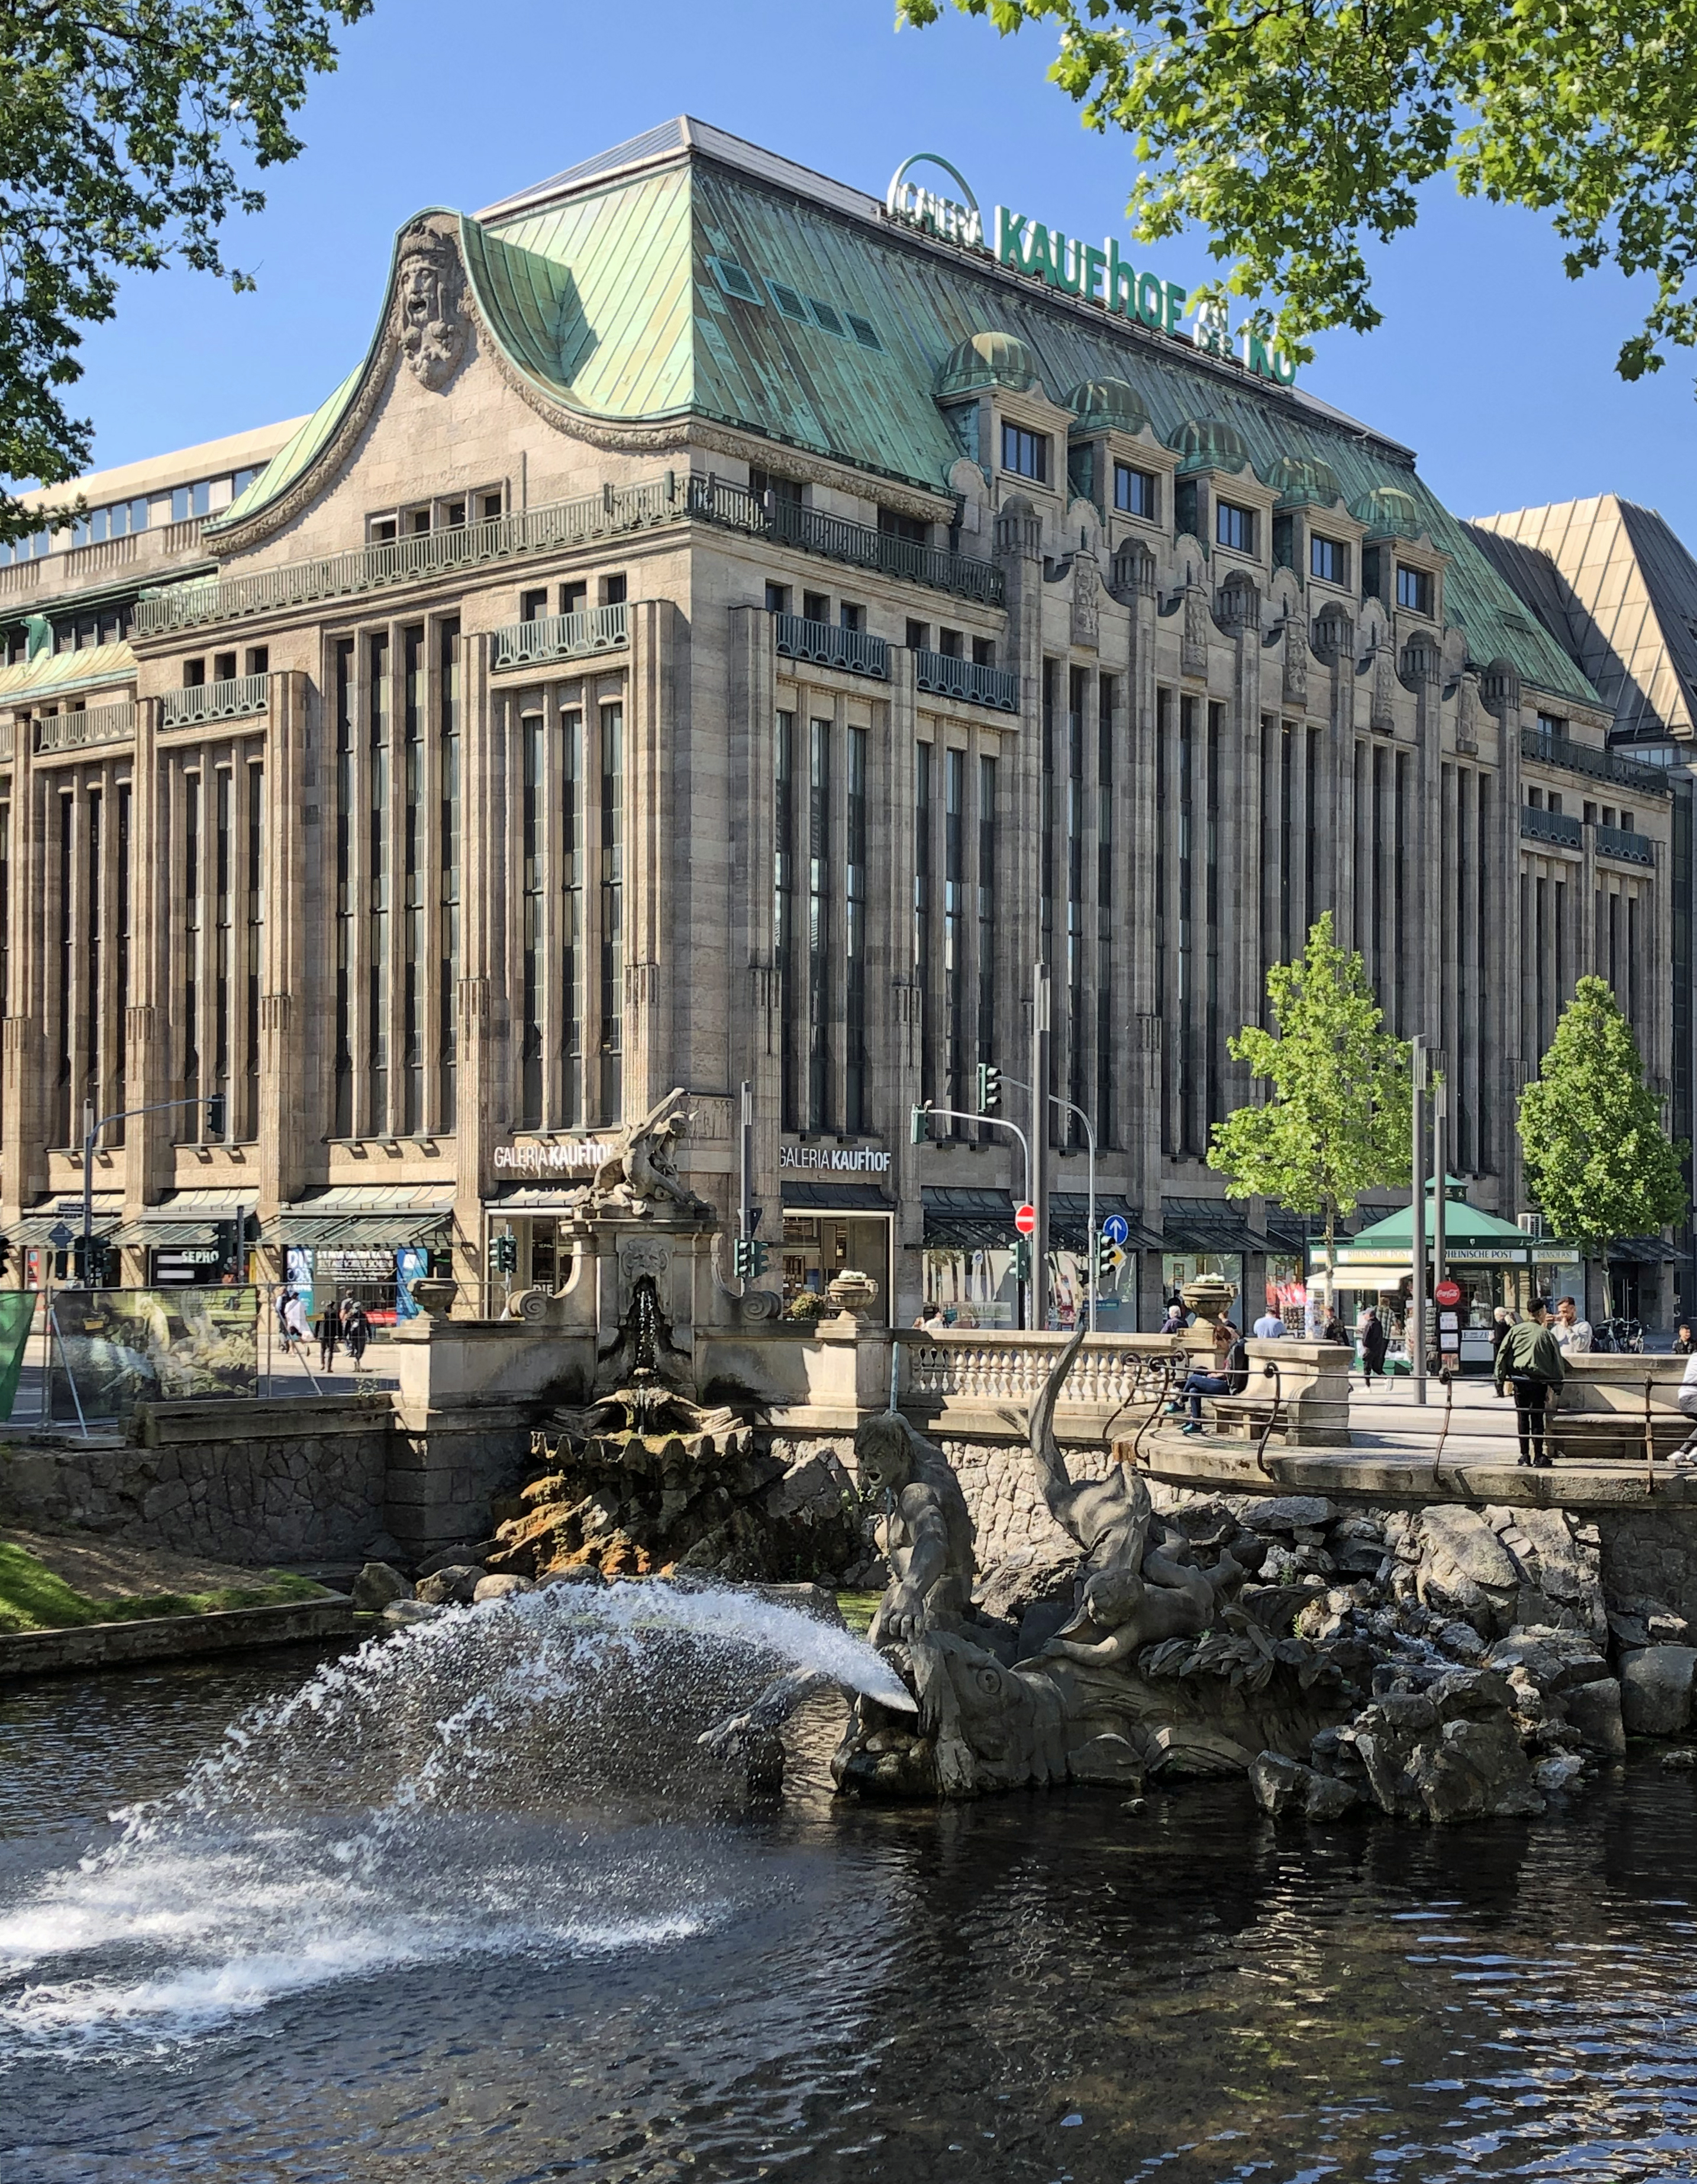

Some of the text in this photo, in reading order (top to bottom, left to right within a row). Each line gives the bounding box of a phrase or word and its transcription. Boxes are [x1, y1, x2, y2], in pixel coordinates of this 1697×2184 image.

[494, 1146, 550, 1167] GALERIA
[780, 1146, 830, 1169] GALERIA
[181, 1251, 219, 1263] SEPHO
[1390, 1250, 1409, 1258] POST
[1491, 1250, 1514, 1259] POST
